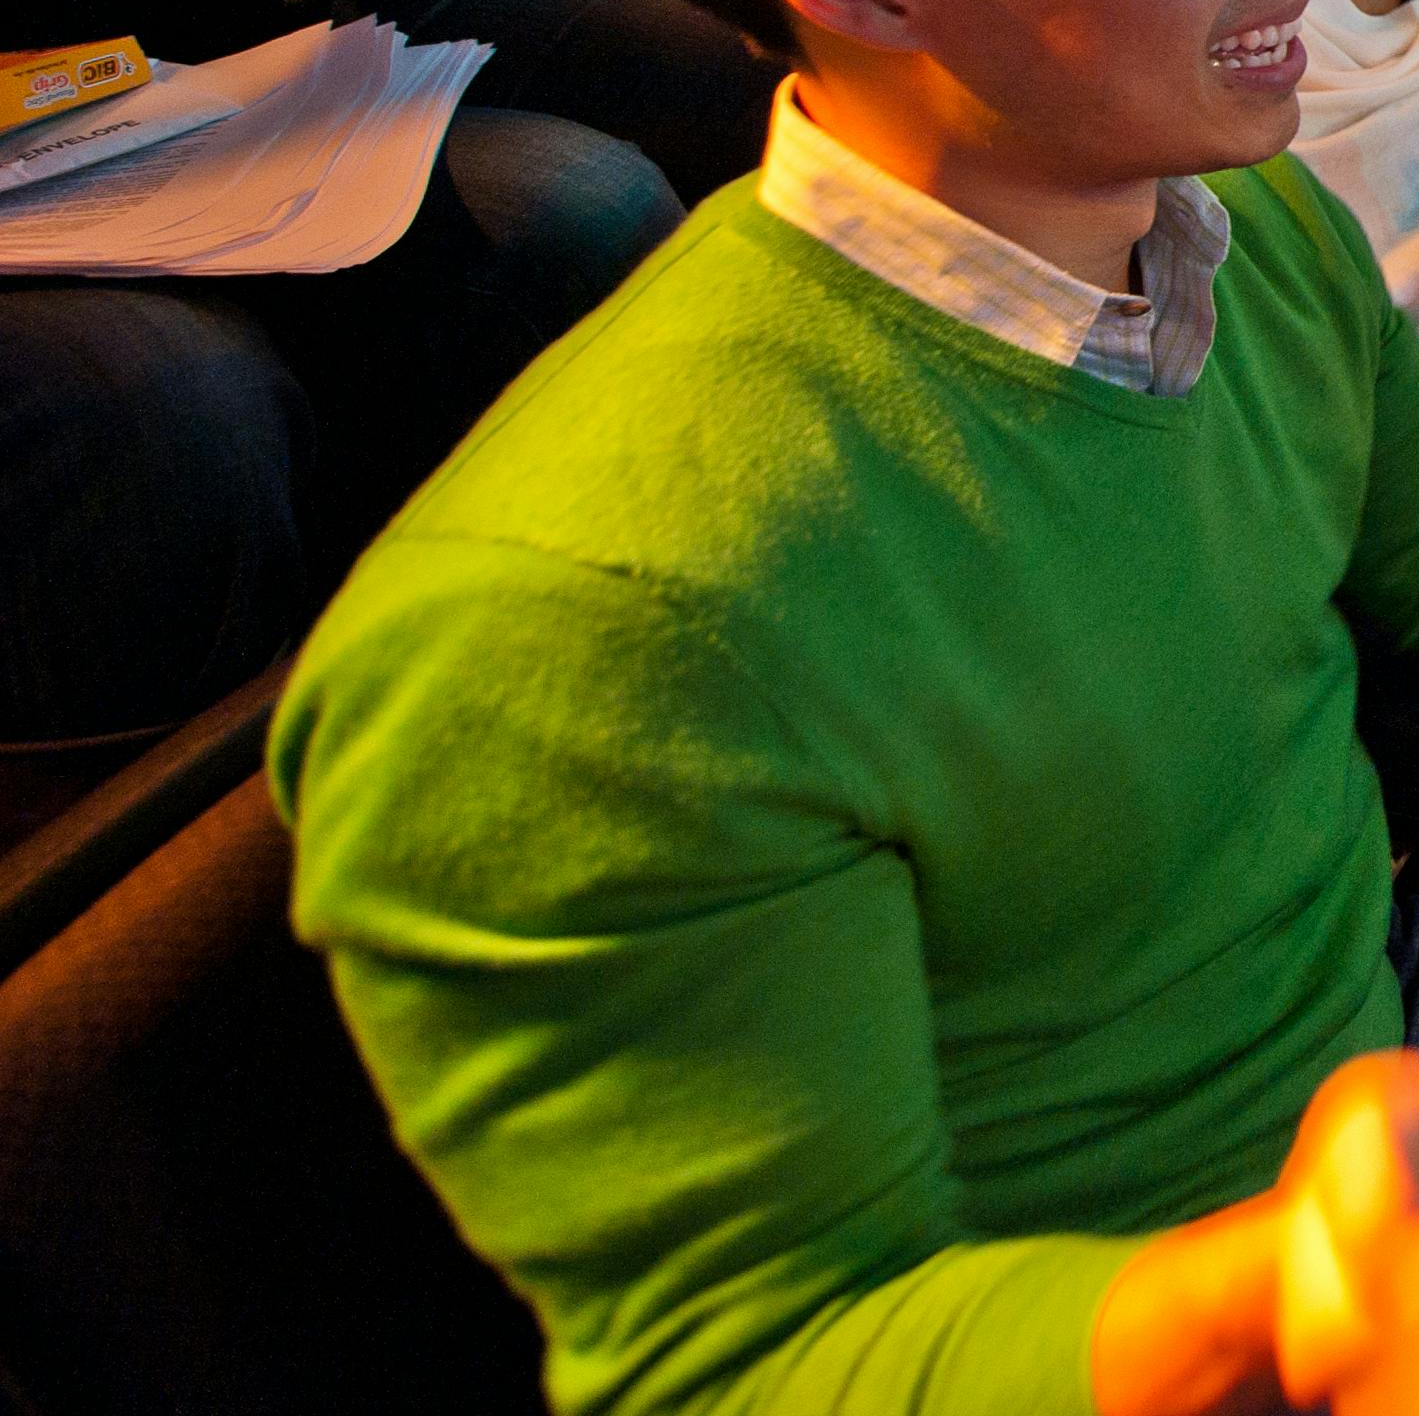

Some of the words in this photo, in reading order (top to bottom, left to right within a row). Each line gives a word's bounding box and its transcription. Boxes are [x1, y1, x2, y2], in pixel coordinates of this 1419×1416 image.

[83, 60, 116, 81] BIC
[34, 74, 69, 92] Grip
[19, 119, 141, 162] ENVELOPE
